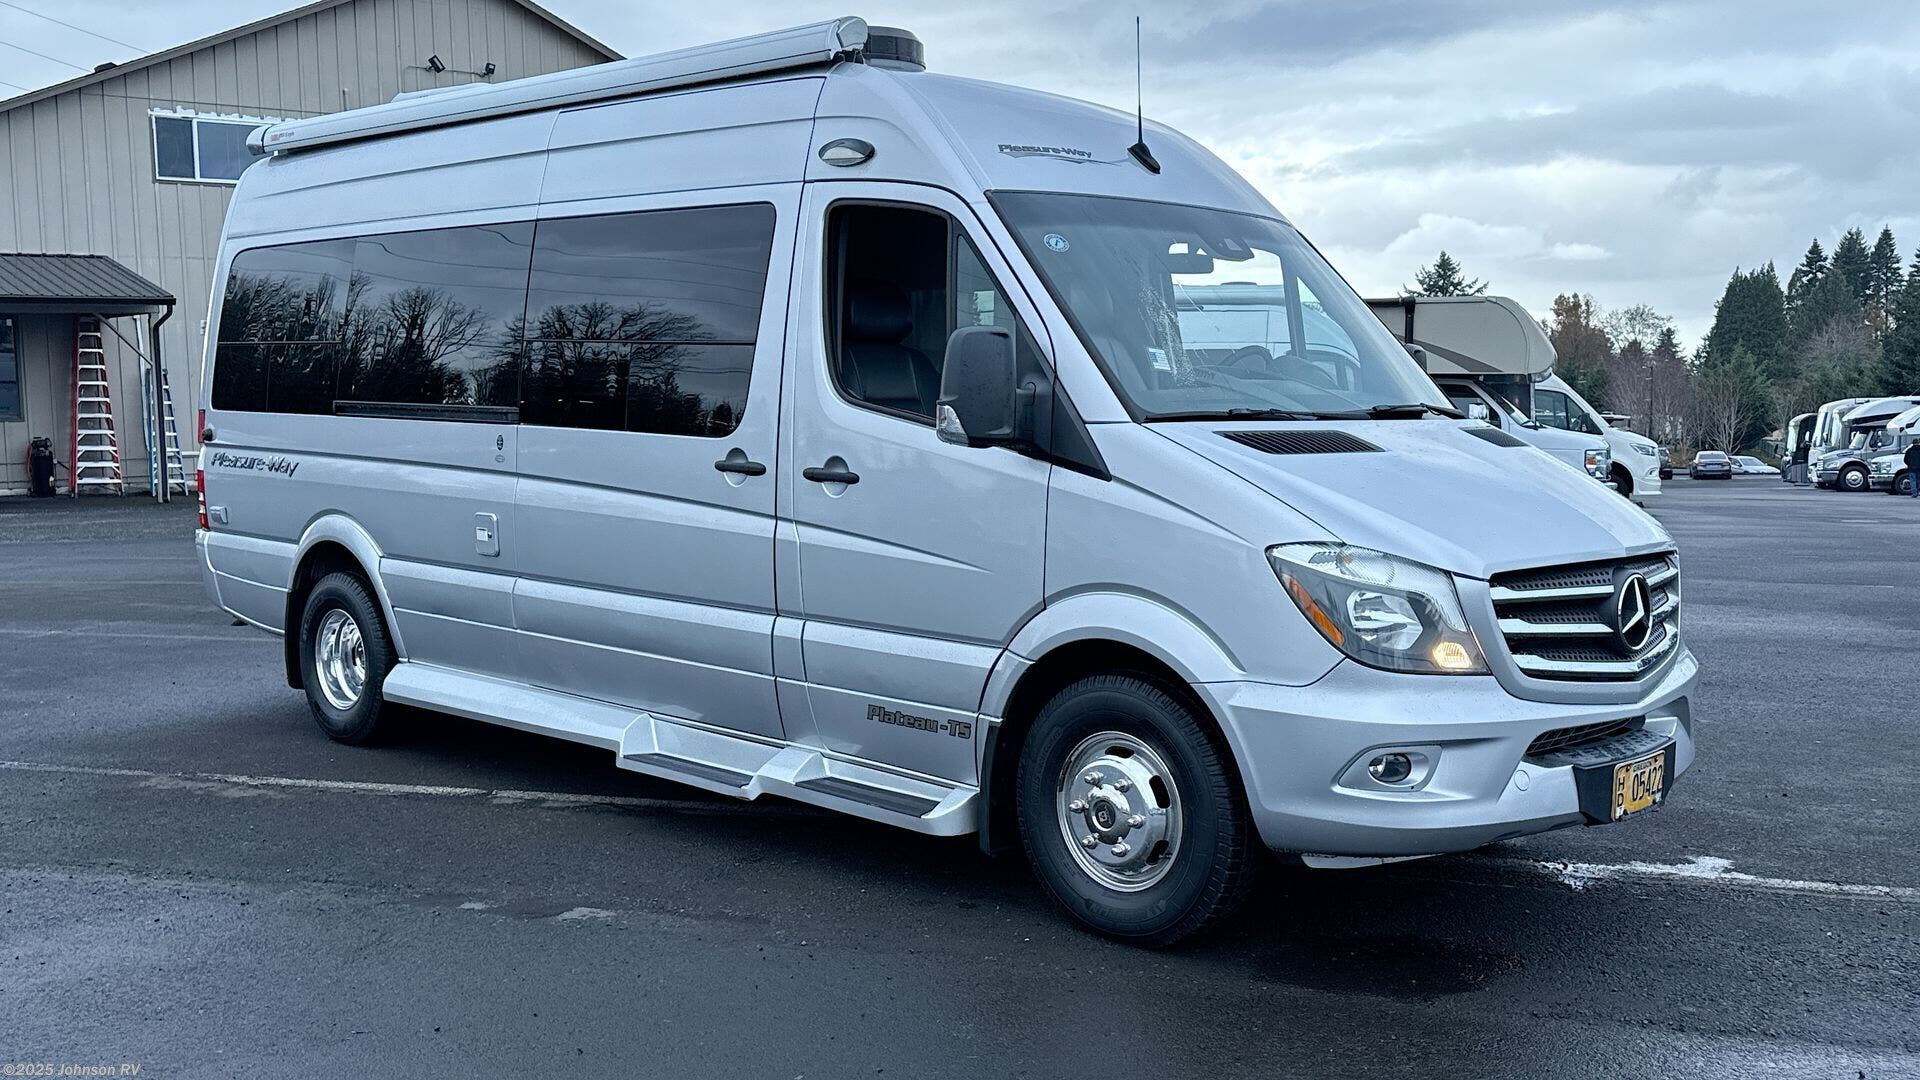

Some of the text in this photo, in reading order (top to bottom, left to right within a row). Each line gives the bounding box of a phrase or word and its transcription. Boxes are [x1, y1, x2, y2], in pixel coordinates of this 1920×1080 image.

[998, 144, 1092, 158] Pleasure-Way
[211, 452, 299, 477] Pleasure-Way
[1631, 764, 1663, 802] 05422
